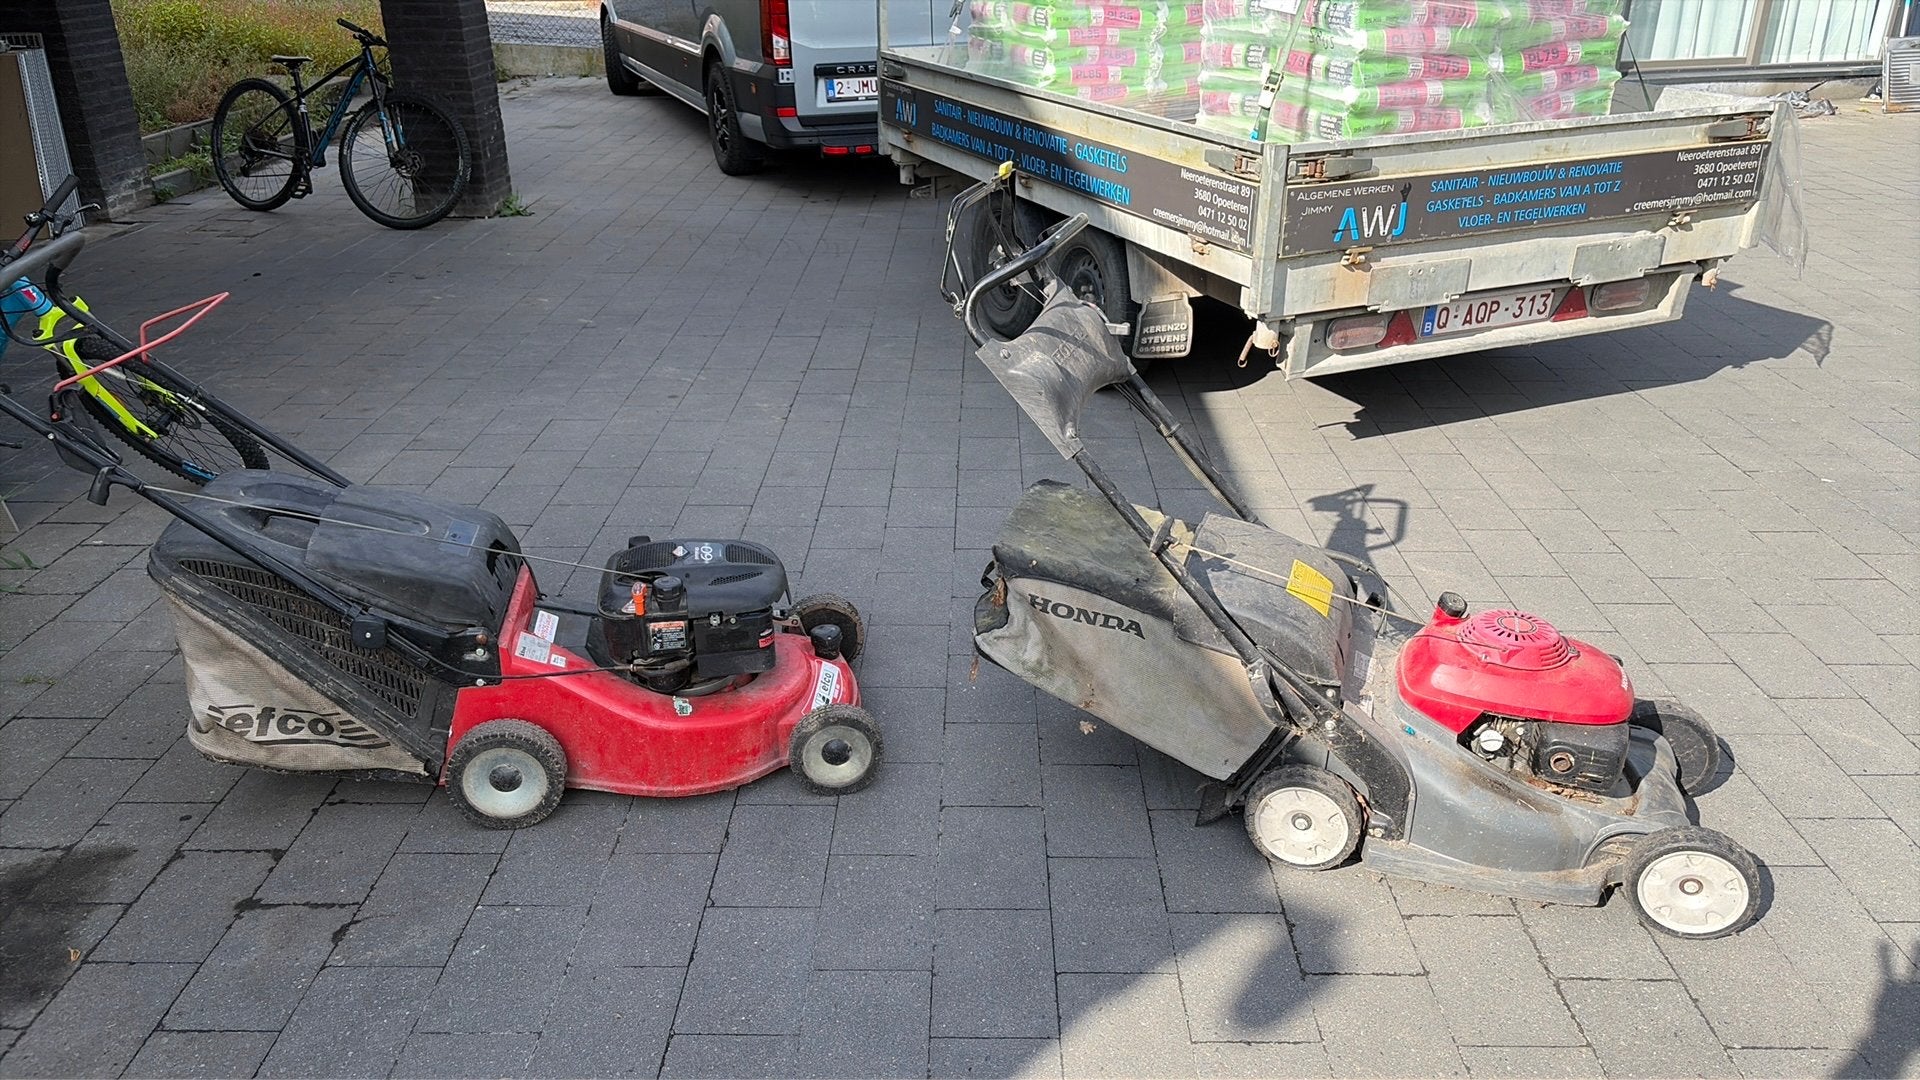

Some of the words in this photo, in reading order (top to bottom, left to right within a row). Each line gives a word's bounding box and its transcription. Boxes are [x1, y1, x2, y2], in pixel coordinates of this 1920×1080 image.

[1528, 48, 1560, 65] PL79
[836, 65, 877, 74] CRAF
[934, 99, 962, 121] SANITAIR
[967, 109, 1014, 138] NIEUWBOUW
[1015, 124, 1022, 140] &
[1023, 126, 1068, 155] RENOVATIE
[1074, 142, 1128, 174] GASKETELS
[1676, 147, 1750, 162] Neeroeterenstraat
[1750, 143, 1762, 154] 89
[931, 122, 970, 149] BADKAMERS
[970, 136, 986, 153] VAN
[986, 143, 993, 156] A
[993, 143, 1009, 162] TOT
[1050, 163, 1062, 181] EN
[1064, 168, 1131, 206] TEGELWERKEN
[1693, 162, 1715, 175] 3680
[1715, 159, 1758, 174] Opoeteren
[1180, 168, 1240, 195] Neeroeterenstraat
[1240, 185, 1250, 198] 89
[1430, 176, 1480, 193] SANITAIR
[1488, 167, 1557, 187] NIEUWBOUW
[1558, 167, 1566, 180] &
[1568, 161, 1624, 178] RENOVATIE
[1697, 177, 1717, 189] 0471
[1720, 175, 1730, 186] 12
[1732, 174, 1743, 185] 50
[1744, 172, 1755, 183] 02
[1193, 187, 1211, 203] 3680
[1212, 193, 1249, 215] Opoeteren
[1296, 188, 1352, 201] ALGEMENE
[1353, 184, 1395, 196] WERKEN
[1426, 195, 1485, 213] GASKETELS
[1493, 187, 1557, 206] BADKAMERS
[1559, 184, 1581, 198] VAN
[1582, 183, 1591, 195] A
[1593, 181, 1613, 194] TOT
[1613, 180, 1622, 193] Z
[1633, 188, 1752, 211] creemersjimmy@hotmail.com
[1197, 205, 1215, 220] 0471
[1217, 211, 1226, 224] 12
[1227, 214, 1237, 227] 50
[1238, 218, 1248, 231] 02
[1301, 205, 1334, 216] JIMMY
[1497, 211, 1511, 225] EN
[1514, 202, 1586, 222] TEGELWERKEN
[1142, 322, 1188, 335] KERENZO
[1424, 322, 1432, 333] B
[1140, 333, 1187, 345] STEVENS
[700, 545, 713, 561] 60
[1028, 593, 1146, 640] HONDA
[225, 706, 335, 737] efco
